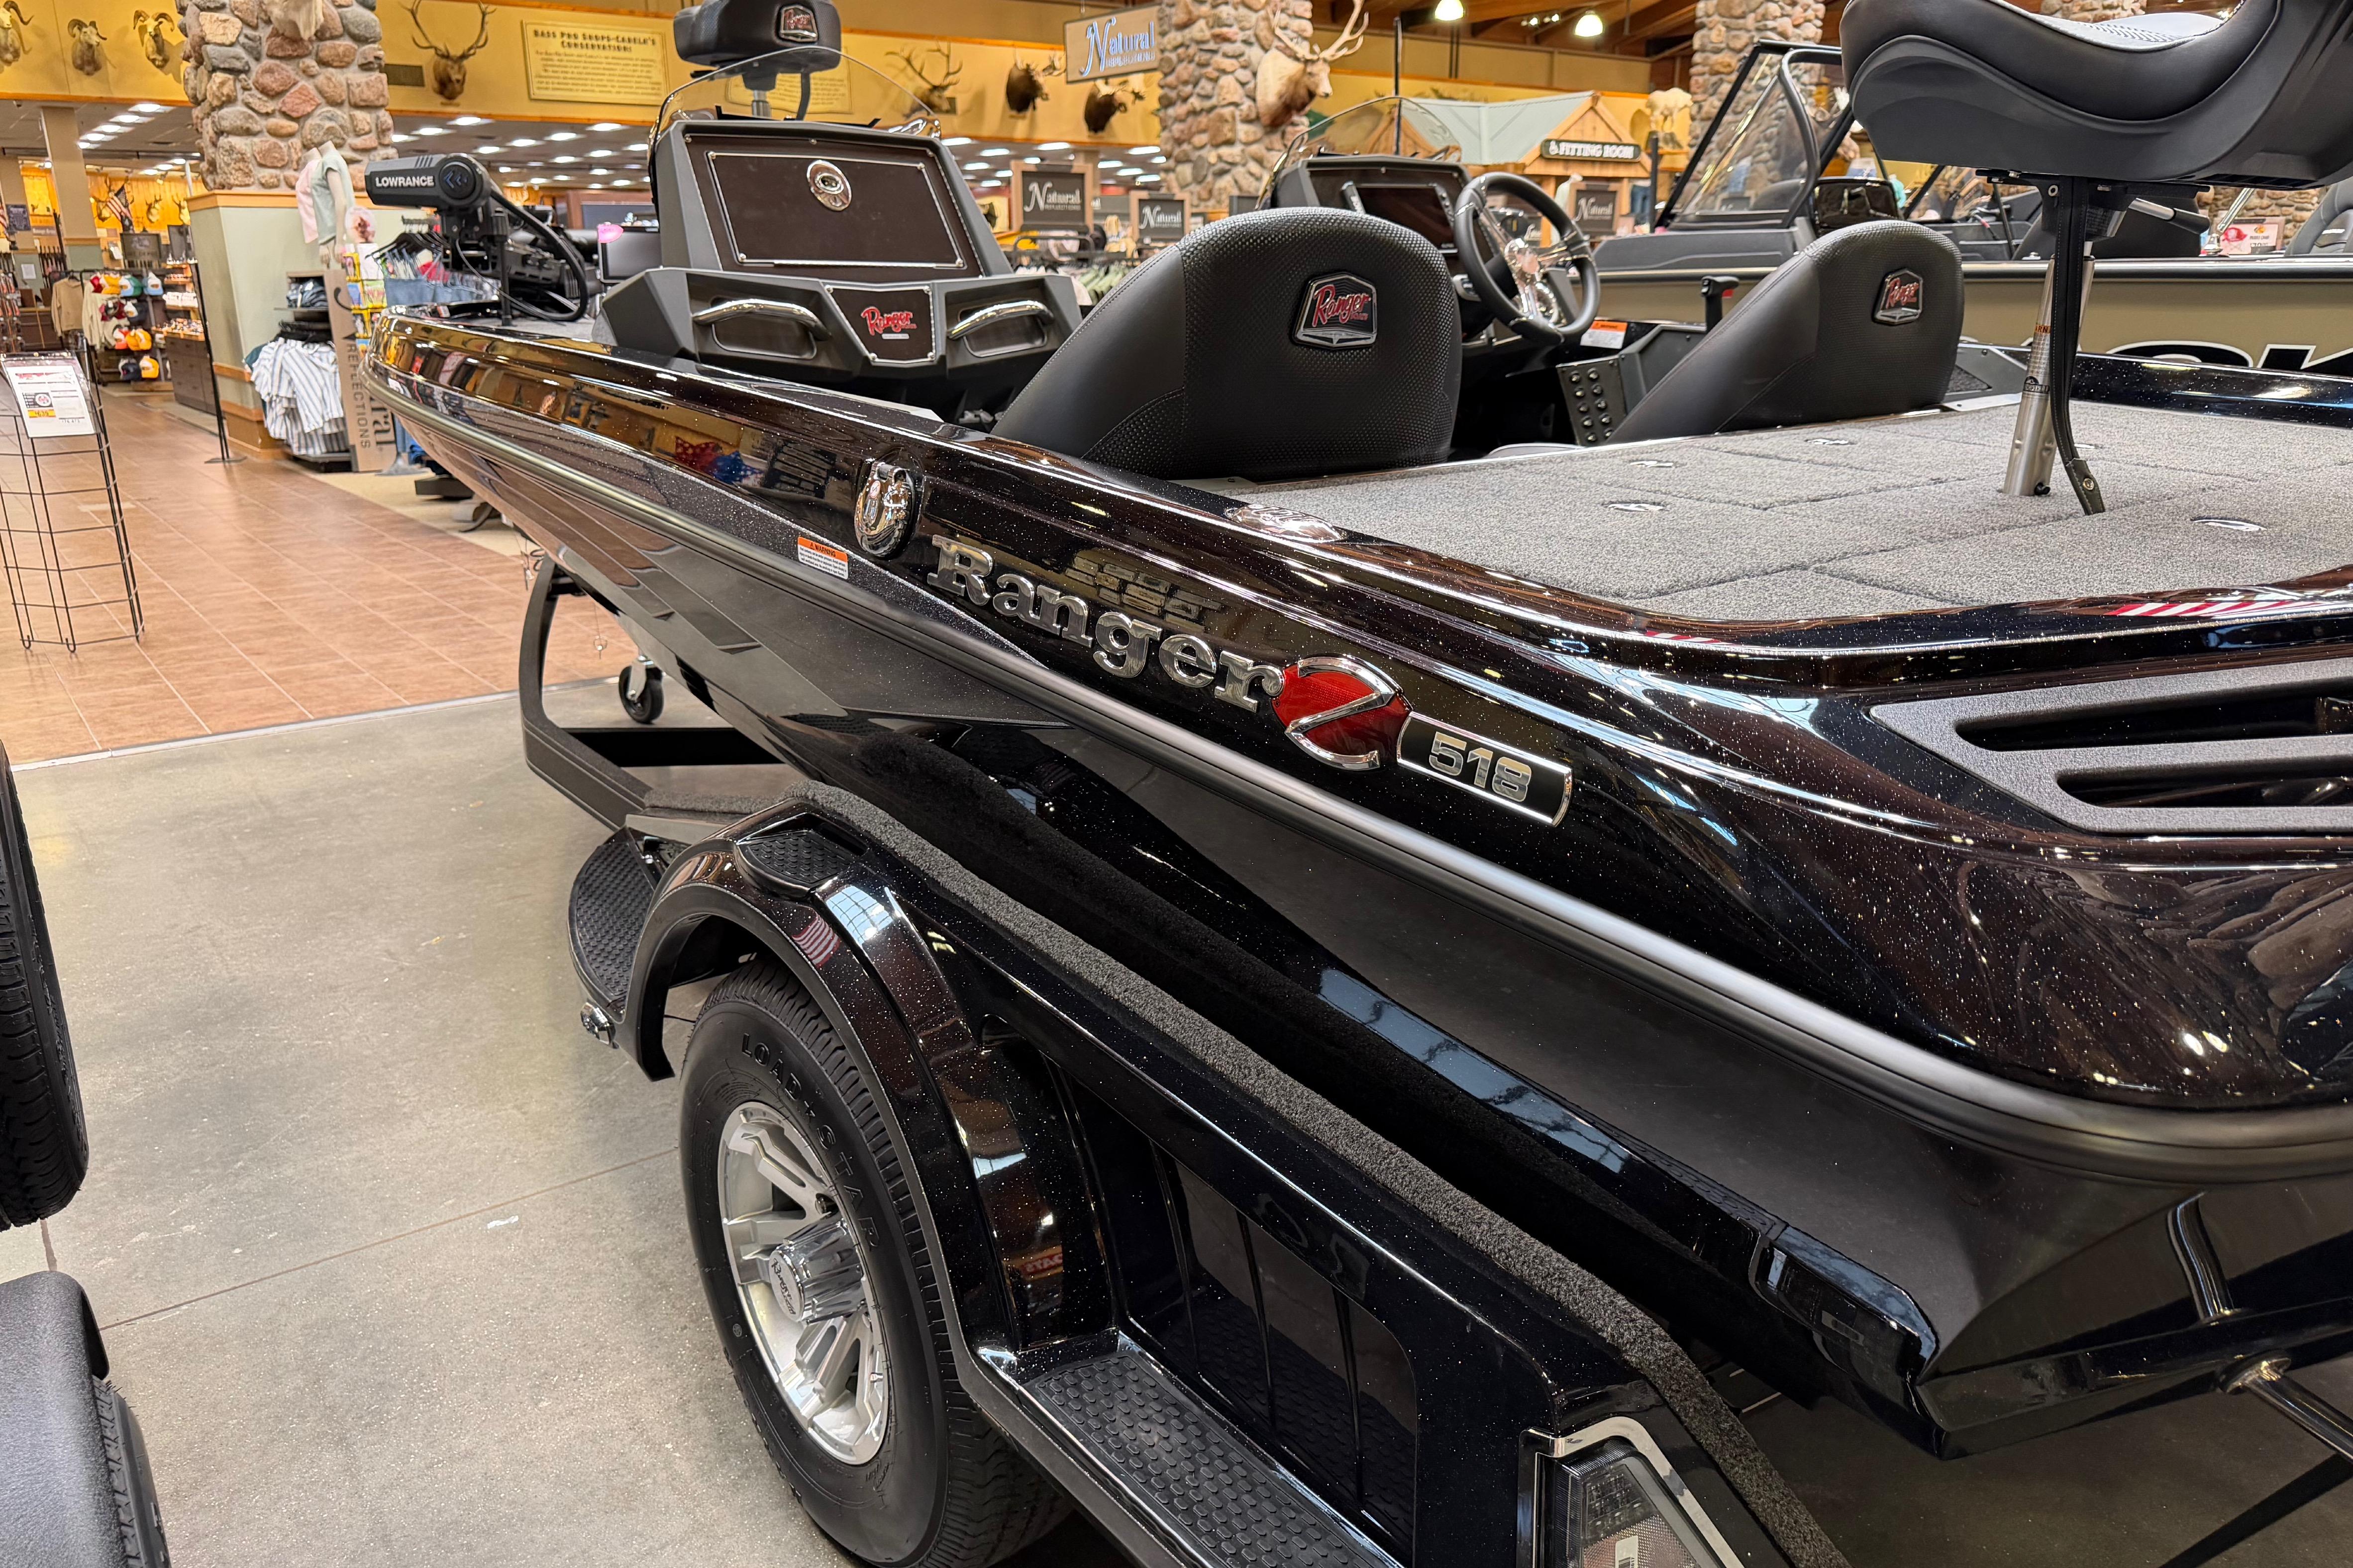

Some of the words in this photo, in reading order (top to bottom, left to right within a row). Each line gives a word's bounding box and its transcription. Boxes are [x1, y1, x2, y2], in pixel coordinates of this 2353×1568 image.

[1079, 17, 1155, 77] Natural
[1559, 142, 1603, 158] FITTING
[1603, 144, 1635, 159] ROOM
[375, 176, 435, 188] LOWRANCE
[1023, 181, 1081, 212] Natural
[1573, 197, 1613, 222] Natural
[1138, 205, 1182, 229] Natural
[1312, 284, 1371, 327] Ranger
[860, 306, 914, 336] Ranger
[814, 544, 836, 557] WARNING
[927, 534, 1285, 713] Ranger
[1429, 731, 1533, 802] 518
